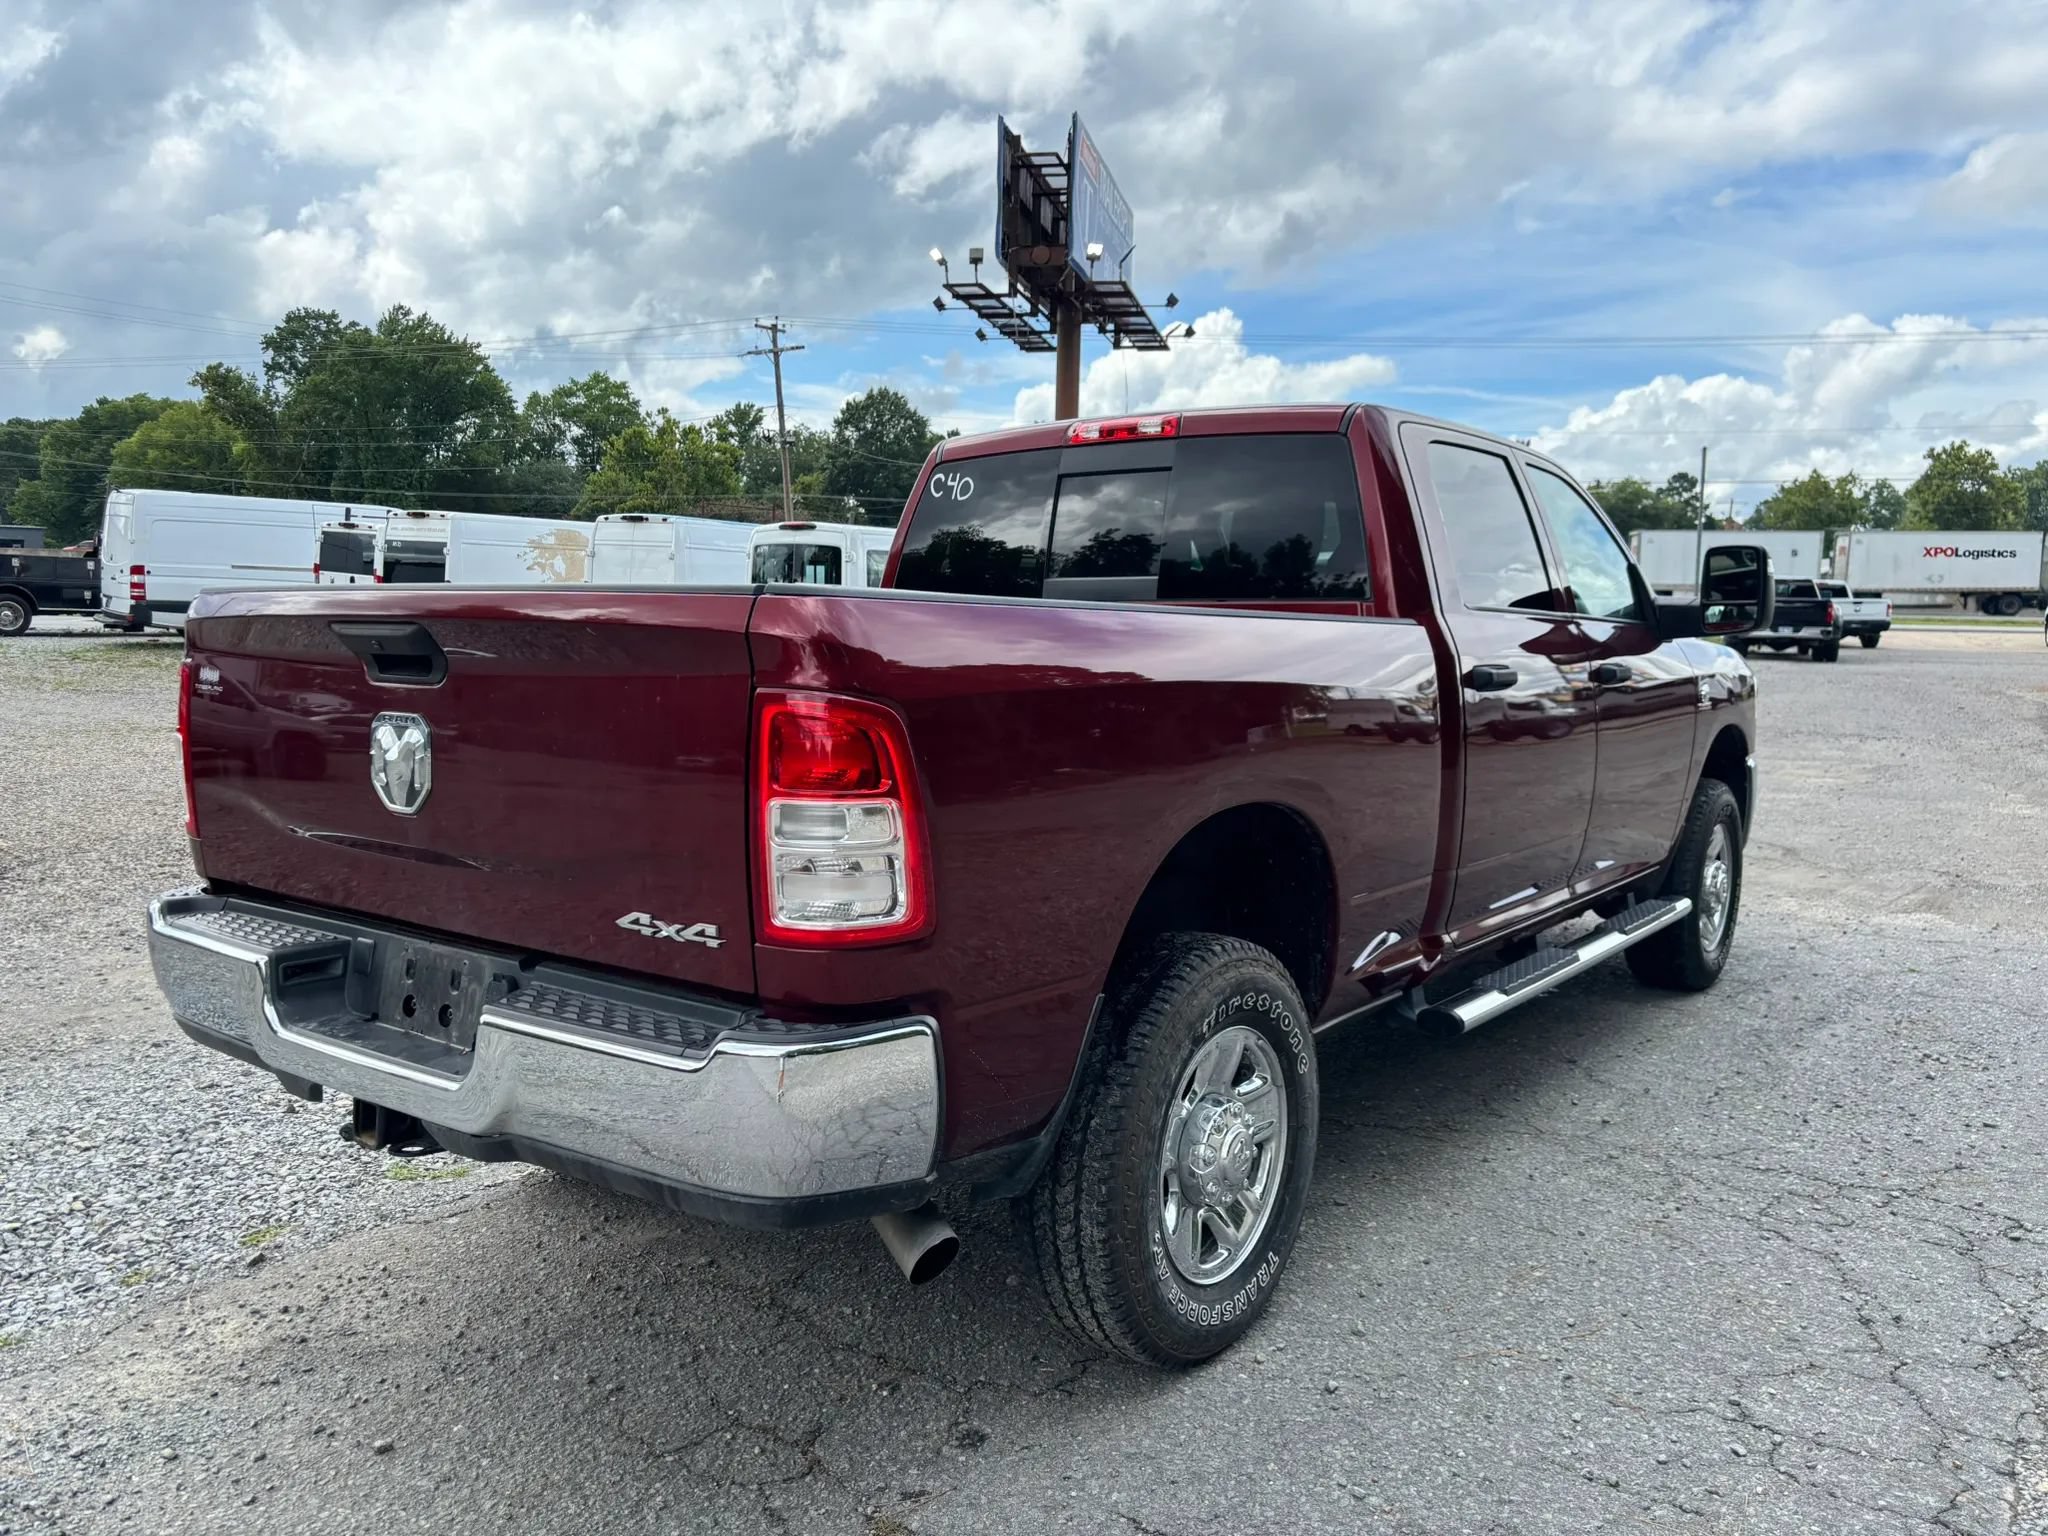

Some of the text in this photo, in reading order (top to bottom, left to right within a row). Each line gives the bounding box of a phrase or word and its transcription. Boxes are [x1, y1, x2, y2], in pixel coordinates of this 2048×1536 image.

[930, 473, 975, 501] C40
[383, 715, 416, 724] RAM
[1203, 992, 1309, 1074] Firestone
[1168, 1251, 1279, 1325] TRANSFORCE
